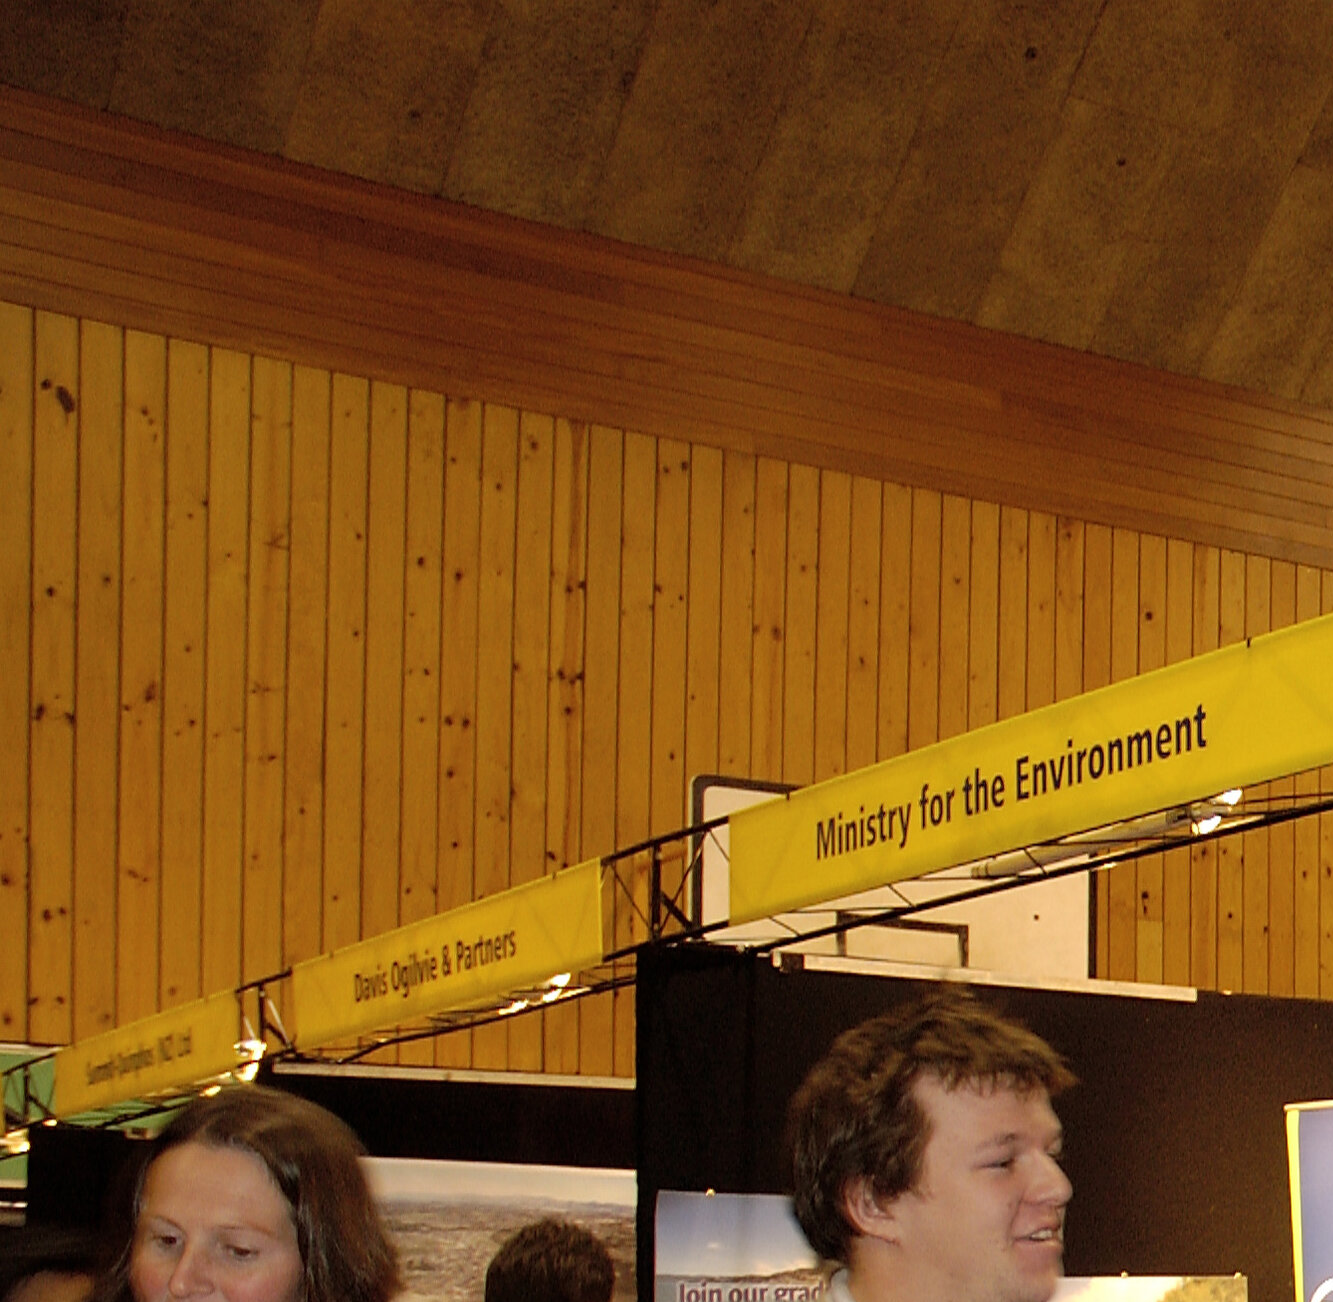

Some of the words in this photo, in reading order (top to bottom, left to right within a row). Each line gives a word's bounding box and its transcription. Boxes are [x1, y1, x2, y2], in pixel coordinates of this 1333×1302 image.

[815, 804, 912, 861] Ministry
[919, 784, 955, 830] for
[963, 767, 1006, 816] the
[1016, 704, 1207, 802] Environment
[353, 964, 388, 1003] Davis
[391, 948, 438, 998] Ogilvie
[441, 944, 453, 978] &
[456, 930, 517, 974] Partners
